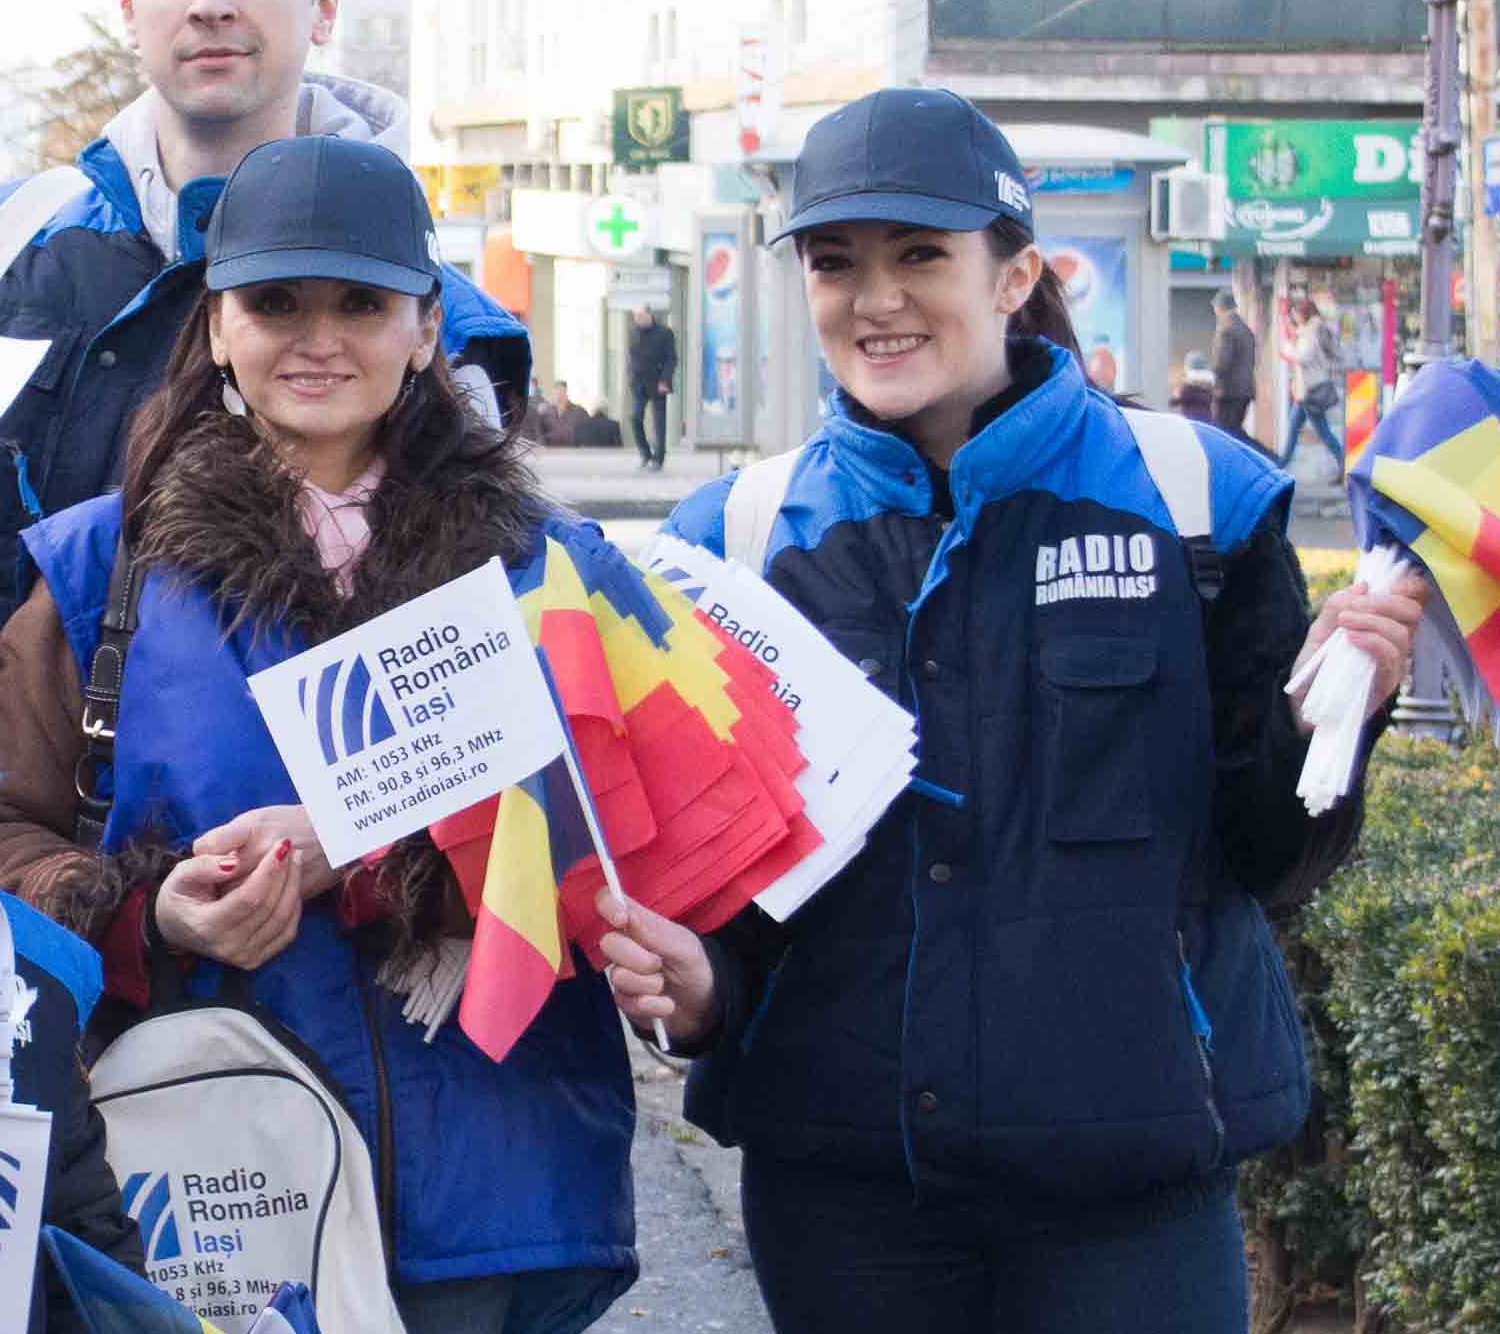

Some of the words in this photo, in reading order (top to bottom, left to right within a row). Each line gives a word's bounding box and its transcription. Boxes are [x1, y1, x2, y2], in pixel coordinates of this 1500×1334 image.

[1035, 534, 1155, 582] RADIO
[378, 625, 460, 674] Radio
[707, 603, 779, 663] Radio
[390, 631, 511, 700] România
[402, 686, 456, 727] Iași
[337, 766, 368, 790] AM:
[372, 747, 409, 773] 1053
[411, 732, 443, 755] KHz
[344, 788, 376, 811] FM:
[378, 770, 413, 796] 90,8
[430, 748, 465, 772] 96,3
[468, 728, 504, 754] MHz
[353, 761, 489, 831] www.radioiasi.ro
[183, 1168, 267, 1196] Radio
[187, 1189, 309, 1222] România
[193, 1228, 243, 1259] Iași
[151, 1263, 188, 1284] 1053
[194, 1259, 225, 1276] KHz
[207, 1280, 241, 1297] 96,3
[247, 1280, 280, 1295] MHz
